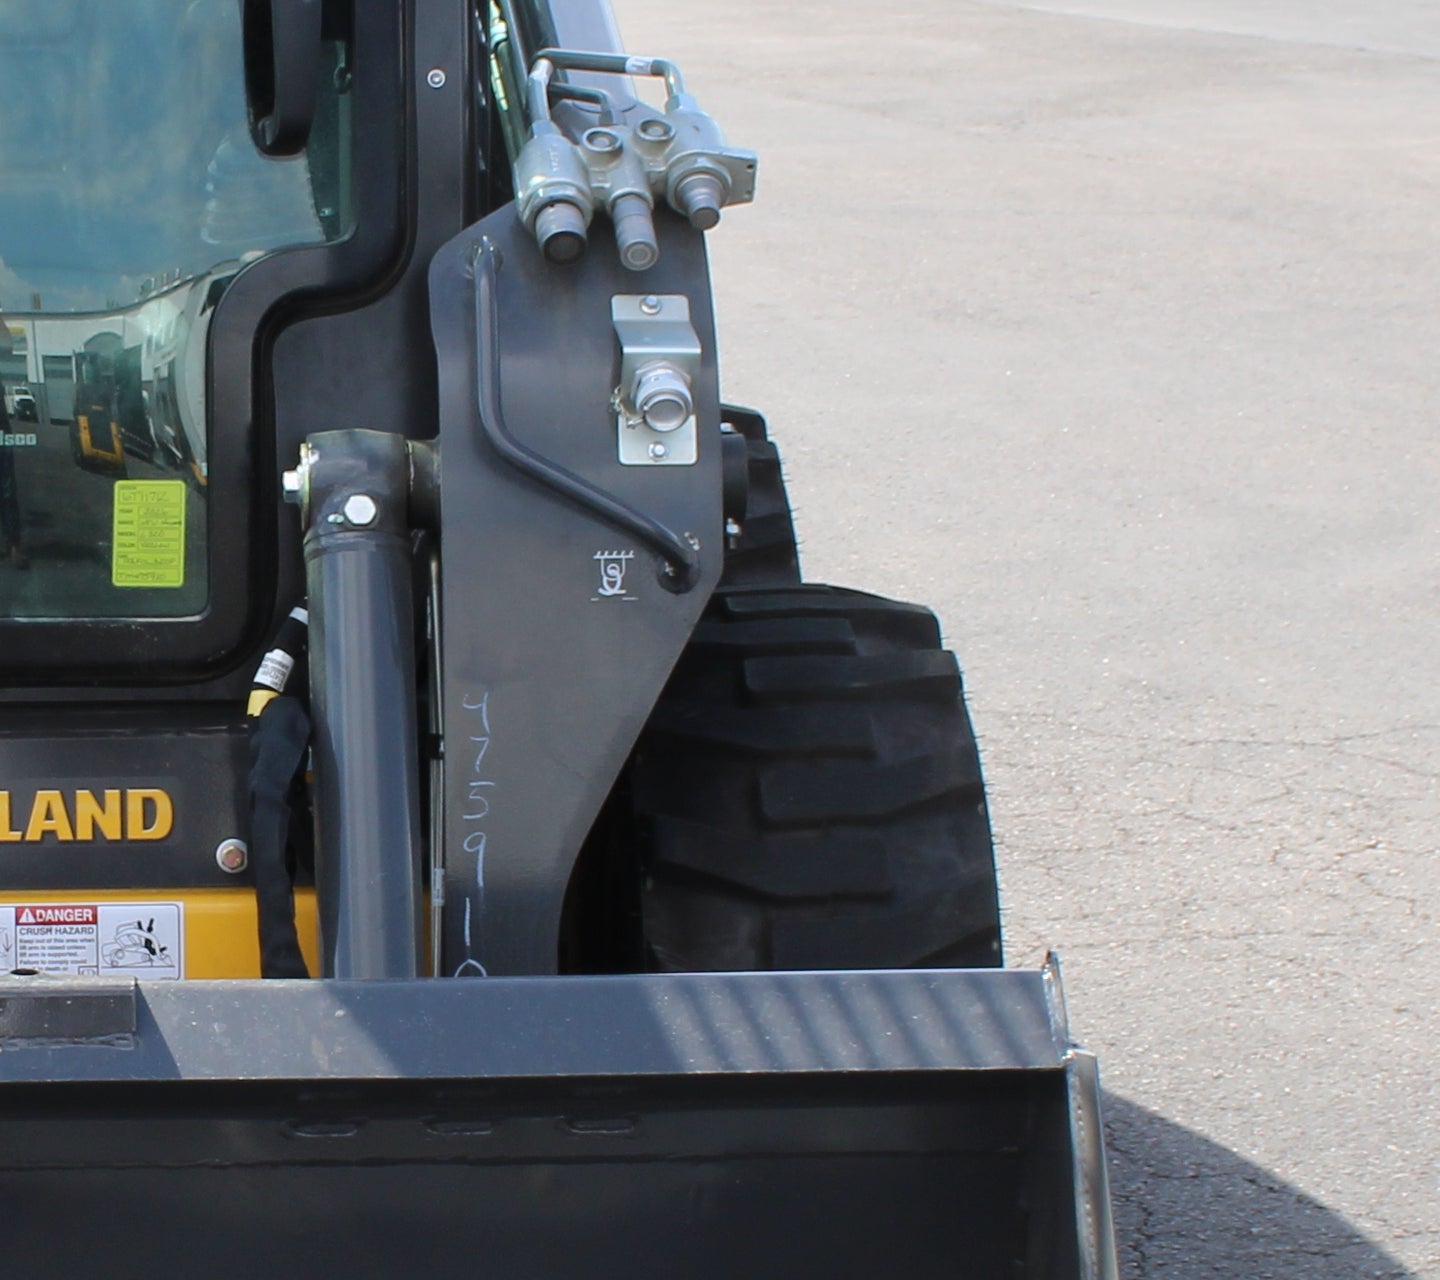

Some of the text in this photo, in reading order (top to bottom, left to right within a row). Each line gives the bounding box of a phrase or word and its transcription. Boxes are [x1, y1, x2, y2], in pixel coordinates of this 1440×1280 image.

[35, 908, 93, 922] DANGER
[19, 926, 95, 936] CRUSH HAZARD
